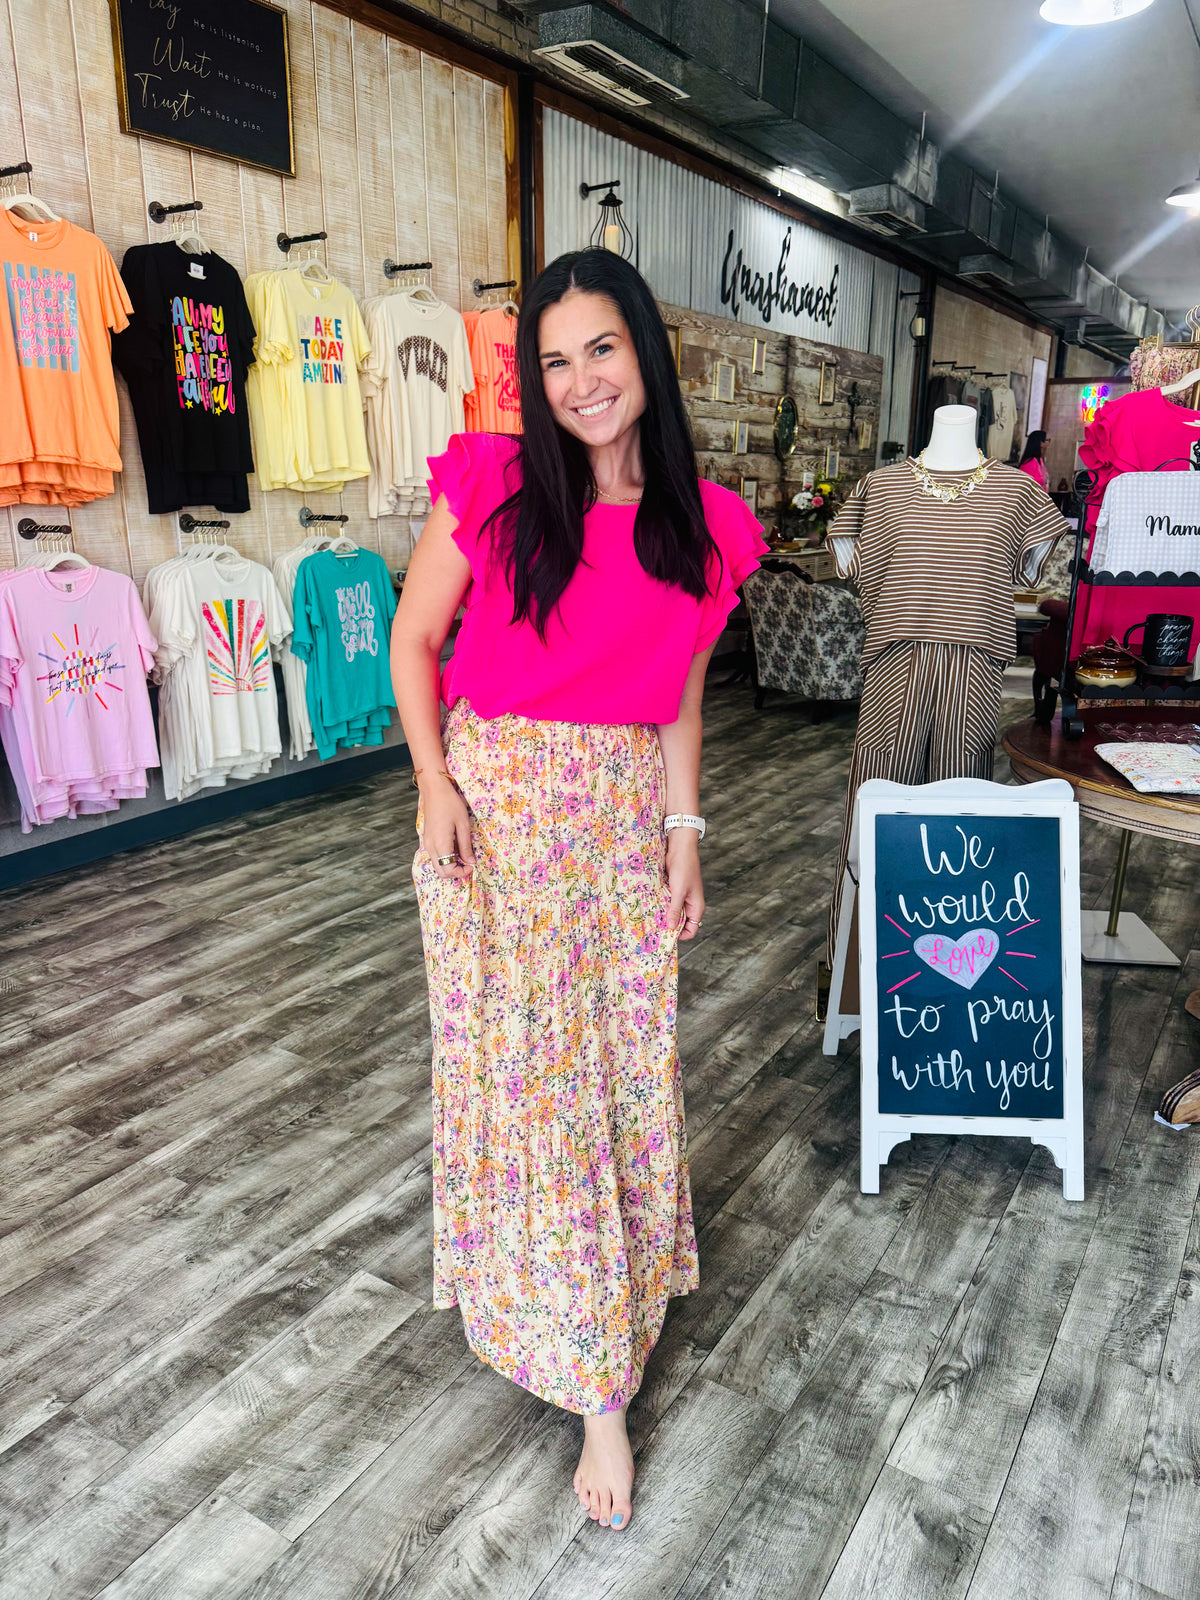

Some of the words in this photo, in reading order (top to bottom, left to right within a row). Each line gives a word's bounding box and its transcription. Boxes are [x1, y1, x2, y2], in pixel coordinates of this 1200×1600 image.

[193, 18, 205, 30] He
[209, 25, 217, 34] is
[221, 29, 264, 53] listening.
[153, 36, 212, 79] Wait
[218, 71, 229, 81] He
[233, 76, 241, 85] is
[245, 81, 280, 99] working.
[133, 73, 195, 121] Trust
[200, 106, 211, 116] He
[215, 110, 230, 122] has
[243, 121, 264, 133] plan.
[34, 292, 62, 310] loud
[22, 311, 66, 326] because
[37, 322, 77, 340] wounds
[22, 343, 50, 358] were
[51, 340, 75, 361] deep
[300, 338, 344, 362] TODAY
[494, 342, 518, 359] THA
[1082, 407, 1096, 423] YO
[1145, 515, 1200, 537] Mam
[919, 823, 995, 875] We
[898, 871, 1036, 928] would
[920, 935, 995, 975] Love
[884, 994, 946, 1038] to
[967, 995, 1055, 1060] pray
[892, 1049, 976, 1093] with
[985, 1060, 1054, 1110] you
